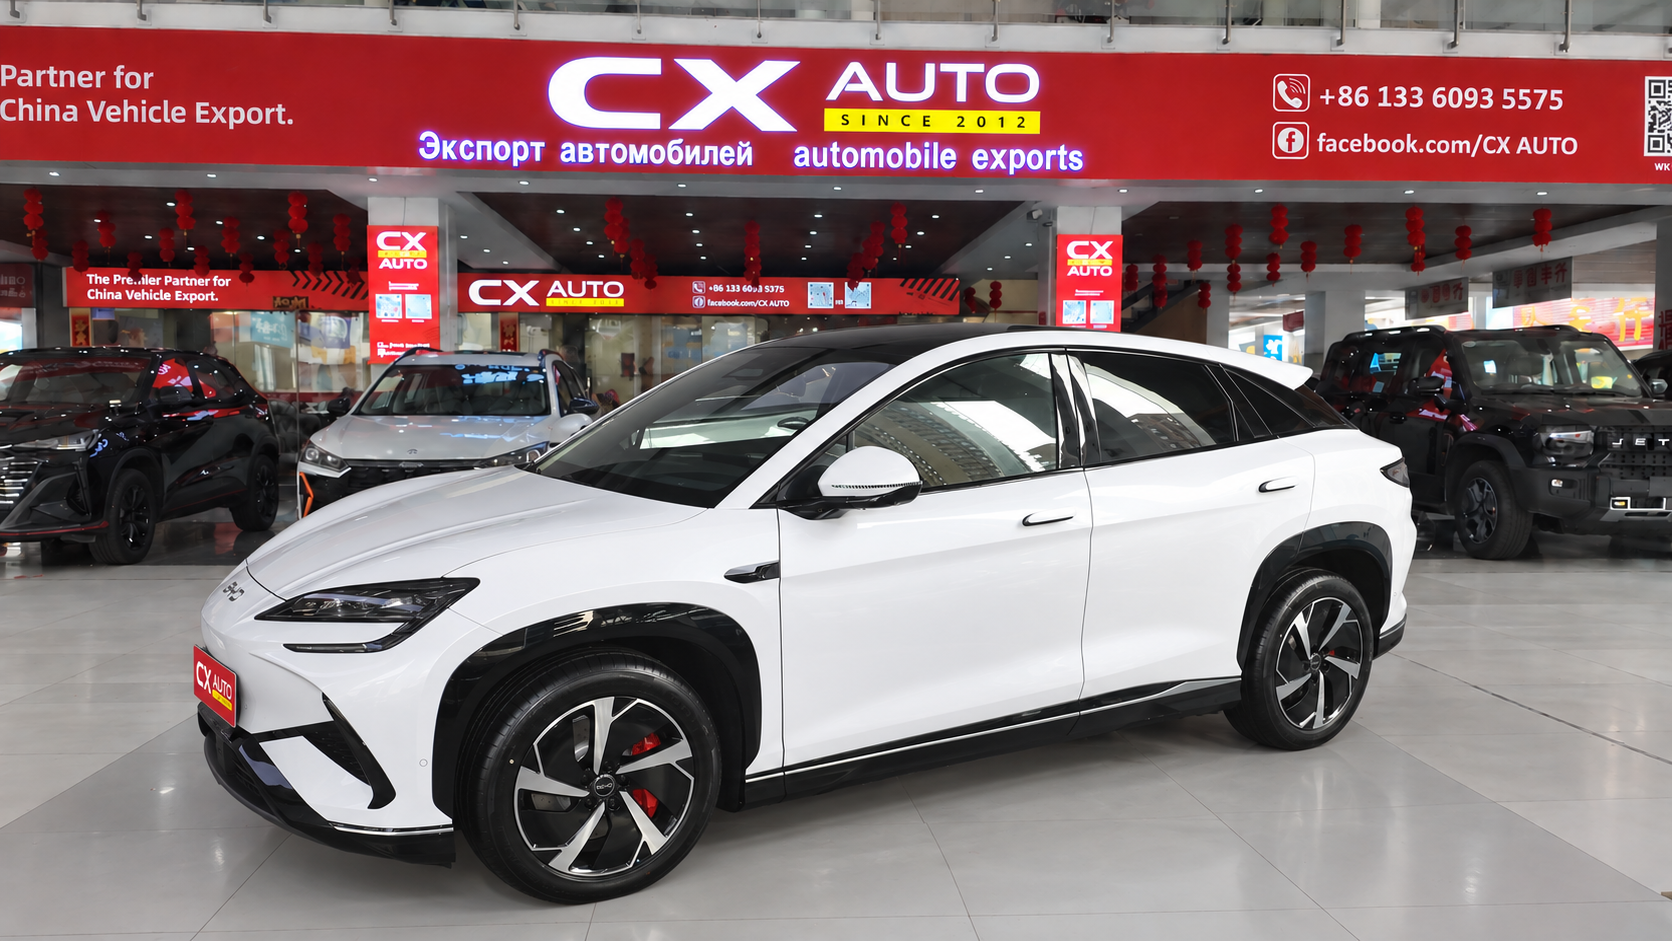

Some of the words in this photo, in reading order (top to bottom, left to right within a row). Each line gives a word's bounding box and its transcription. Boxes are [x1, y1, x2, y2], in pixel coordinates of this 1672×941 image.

[1, 65, 105, 88] Partner
[114, 65, 153, 89] for
[549, 57, 800, 131] CX
[826, 62, 1039, 102] AUTO
[1320, 86, 1368, 106] +86
[1378, 86, 1423, 107] 133
[1433, 87, 1493, 109] 6093
[1502, 89, 1563, 110] 5575
[0, 98, 77, 121] China
[87, 100, 186, 123] Vehicle
[196, 102, 293, 129] Export.
[842, 114, 930, 127] SINCE
[957, 116, 1025, 128] 2012
[419, 131, 545, 166] Экспорт
[561, 139, 752, 165] автомобилей
[1317, 133, 1510, 157] facebook.com/CX
[1516, 137, 1577, 154] AUTO
[794, 142, 956, 169] automobile
[972, 145, 1083, 175] exports
[377, 232, 426, 250] CX
[1067, 241, 1113, 259] CX
[379, 258, 427, 269] AUTO
[1067, 266, 1112, 276] AUTO
[87, 274, 110, 284] The
[165, 276, 210, 286] Partner
[213, 276, 231, 286] for
[87, 289, 122, 299] China
[125, 289, 171, 300] Vehicle
[175, 291, 218, 303] Export.
[469, 280, 539, 305] CX
[547, 281, 624, 297] AUTO
[196, 661, 211, 694] CX
[212, 674, 232, 701] AUTO
